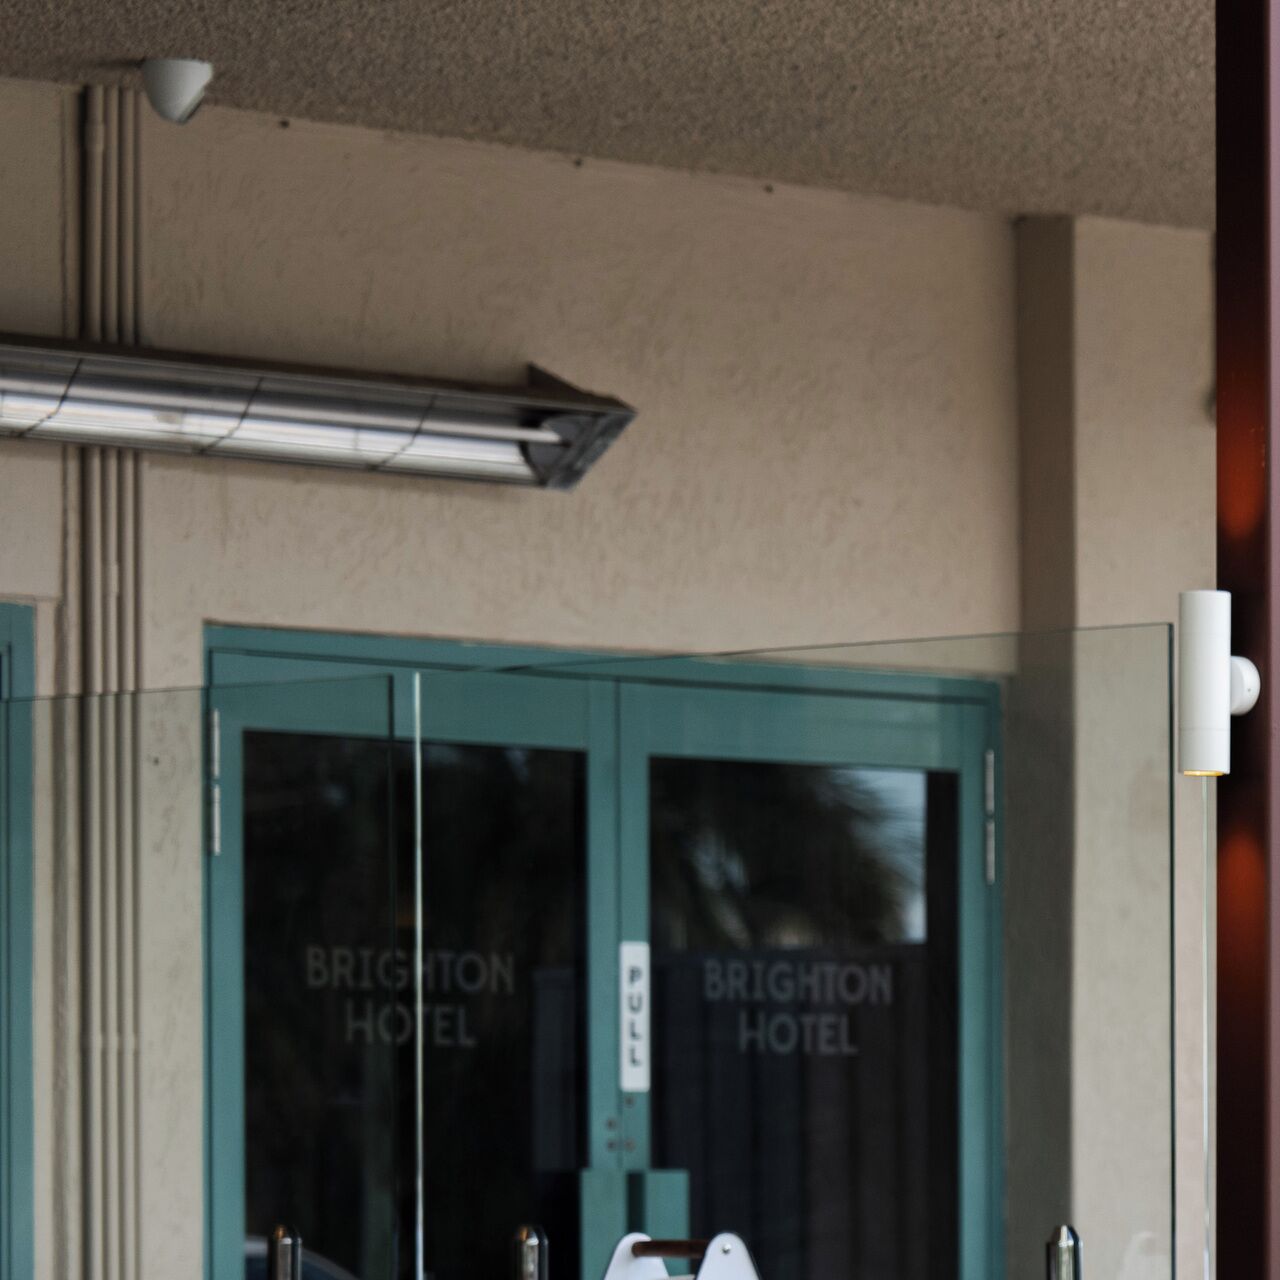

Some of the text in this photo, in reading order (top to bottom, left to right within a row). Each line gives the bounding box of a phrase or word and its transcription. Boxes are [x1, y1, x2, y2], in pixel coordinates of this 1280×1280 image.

[305, 944, 516, 995] BRIGHTON
[703, 957, 893, 1006] BRIGHTON
[626, 964, 643, 1067] PULL
[737, 1009, 861, 1056] HOTEL
